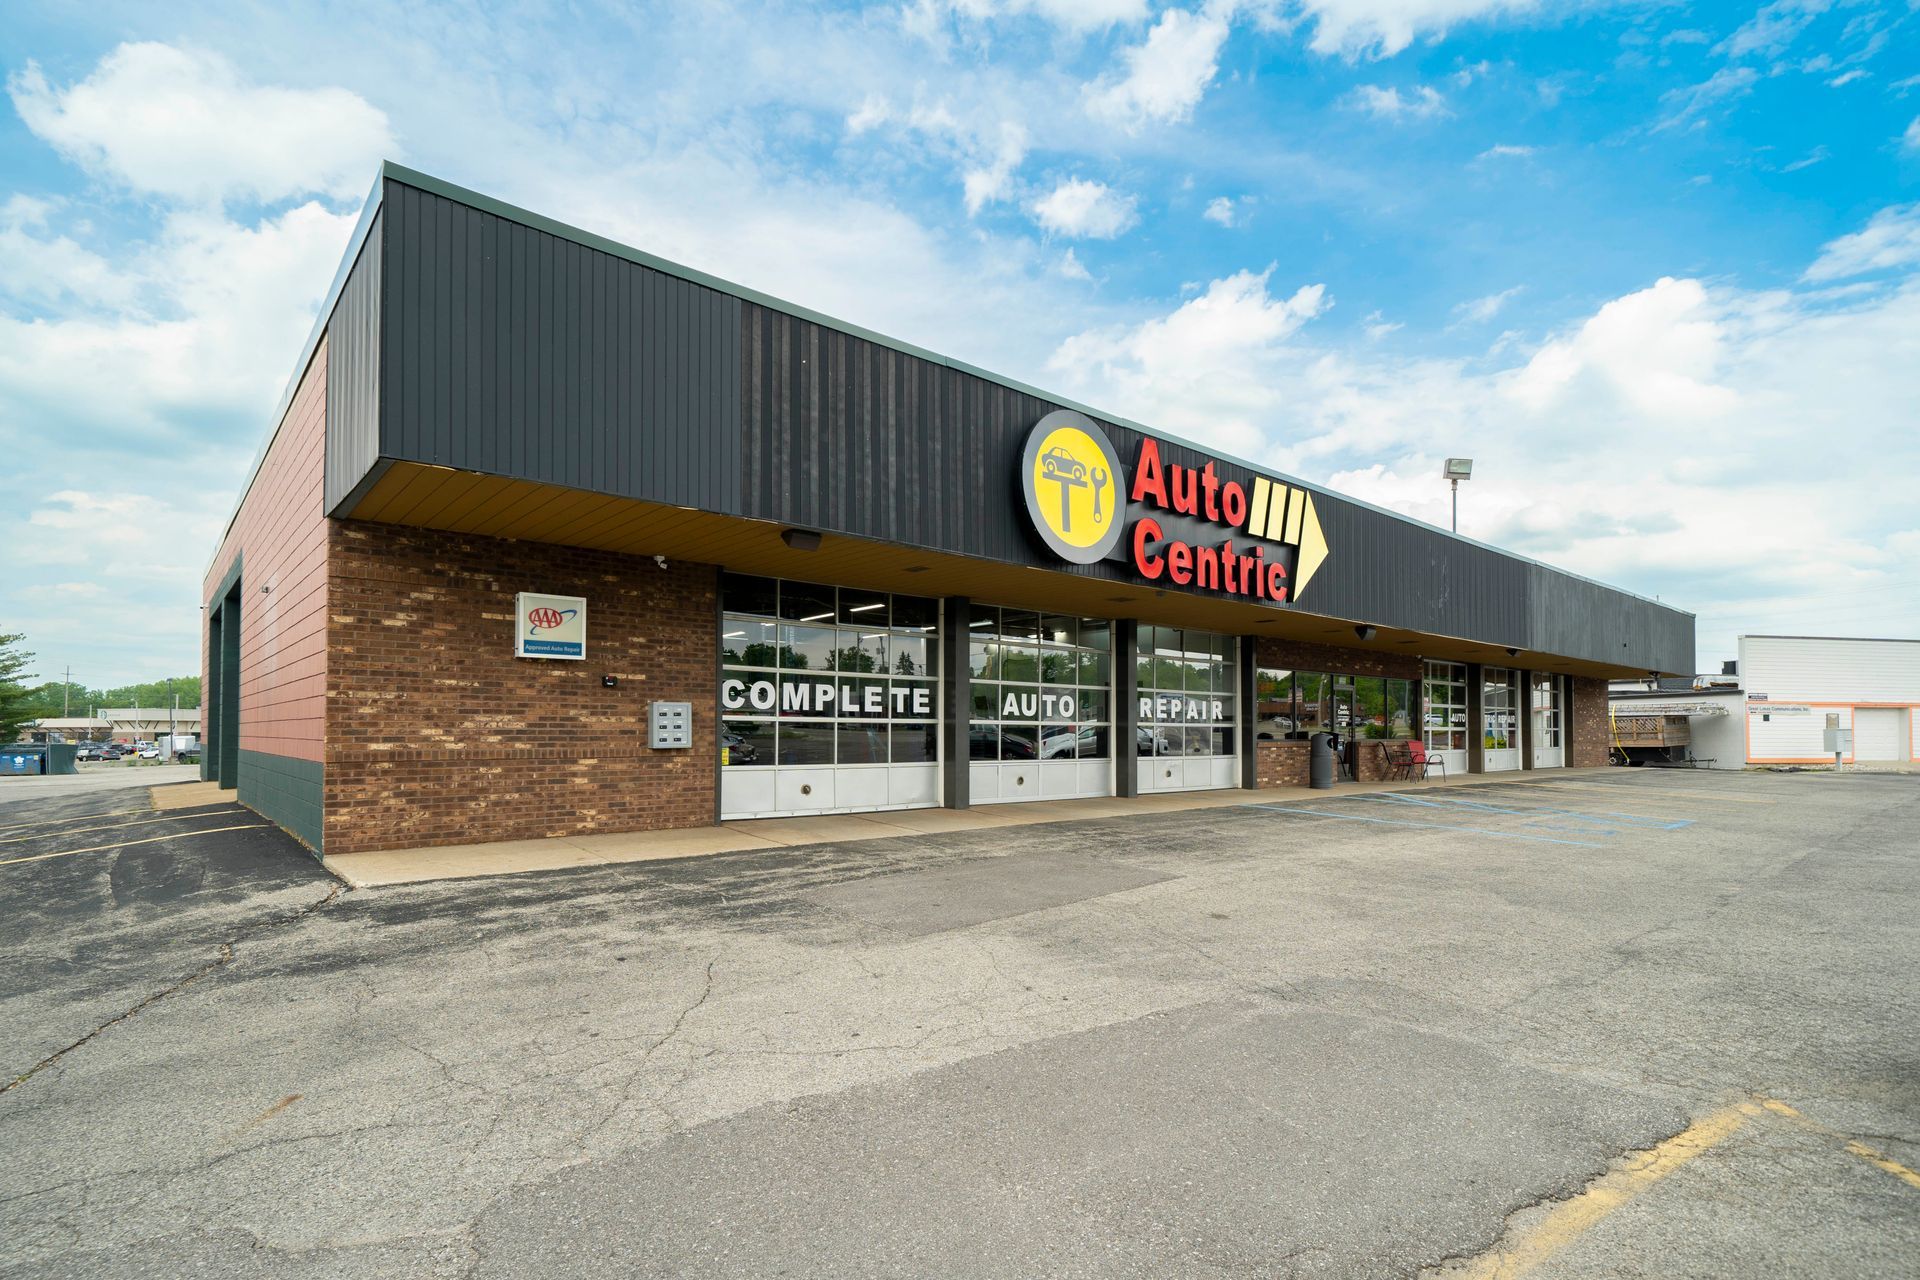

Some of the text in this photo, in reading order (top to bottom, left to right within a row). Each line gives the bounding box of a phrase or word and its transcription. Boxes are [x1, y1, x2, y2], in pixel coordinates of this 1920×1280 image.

[1131, 437, 1247, 527] Auto
[1133, 517, 1288, 602] Centric
[531, 608, 561, 628] AAA
[525, 644, 550, 652] Approved
[564, 646, 580, 654] Repair
[722, 679, 1223, 720] COMPLETE AUTO REPAIR
[1451, 713, 1466, 722] AUTO
